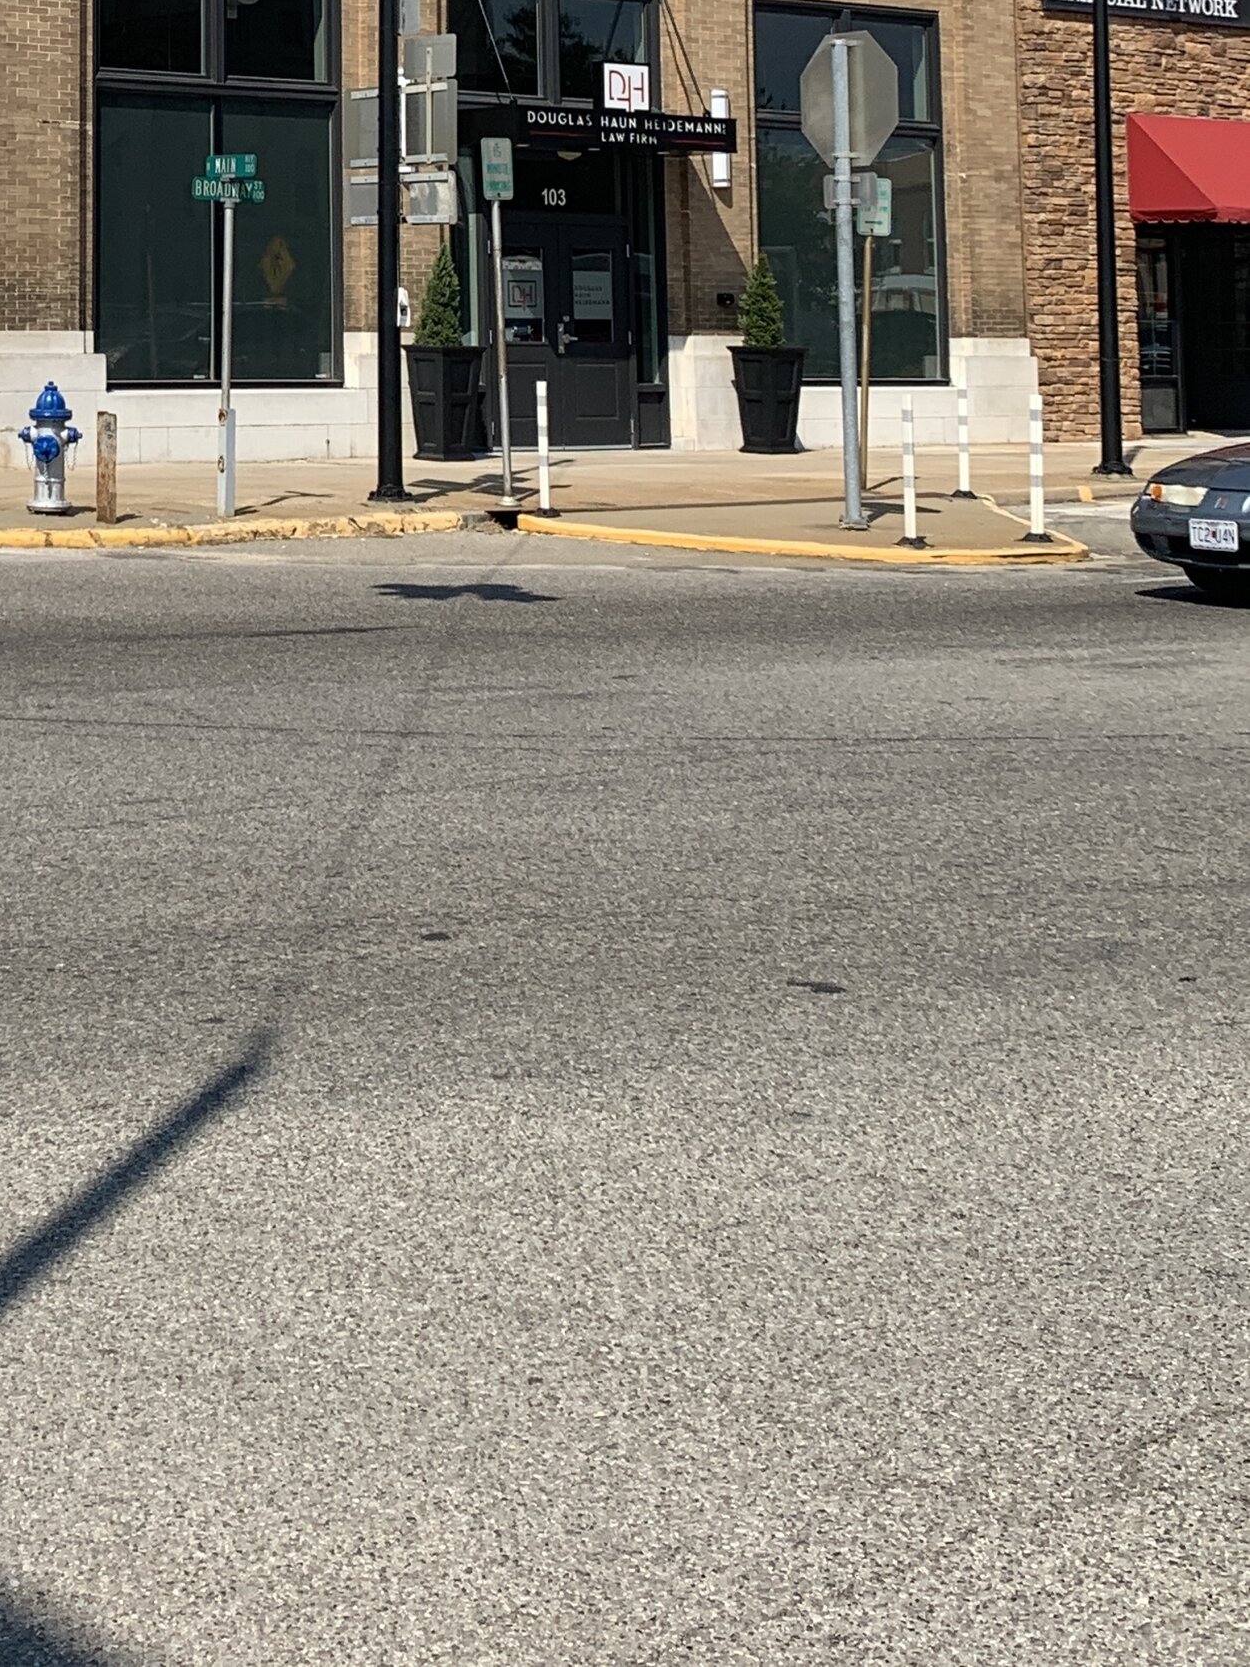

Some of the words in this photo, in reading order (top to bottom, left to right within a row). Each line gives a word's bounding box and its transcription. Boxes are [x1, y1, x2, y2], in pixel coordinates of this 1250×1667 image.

[527, 110, 592, 126] DOUGLAS
[601, 115, 637, 129] HAUN
[644, 118, 722, 134] HEIDEMANN
[601, 131, 625, 142] LAW
[629, 133, 658, 145] FIRM
[214, 157, 236, 173] MAIN
[195, 179, 252, 199] BROADWAY
[541, 188, 567, 206] 103
